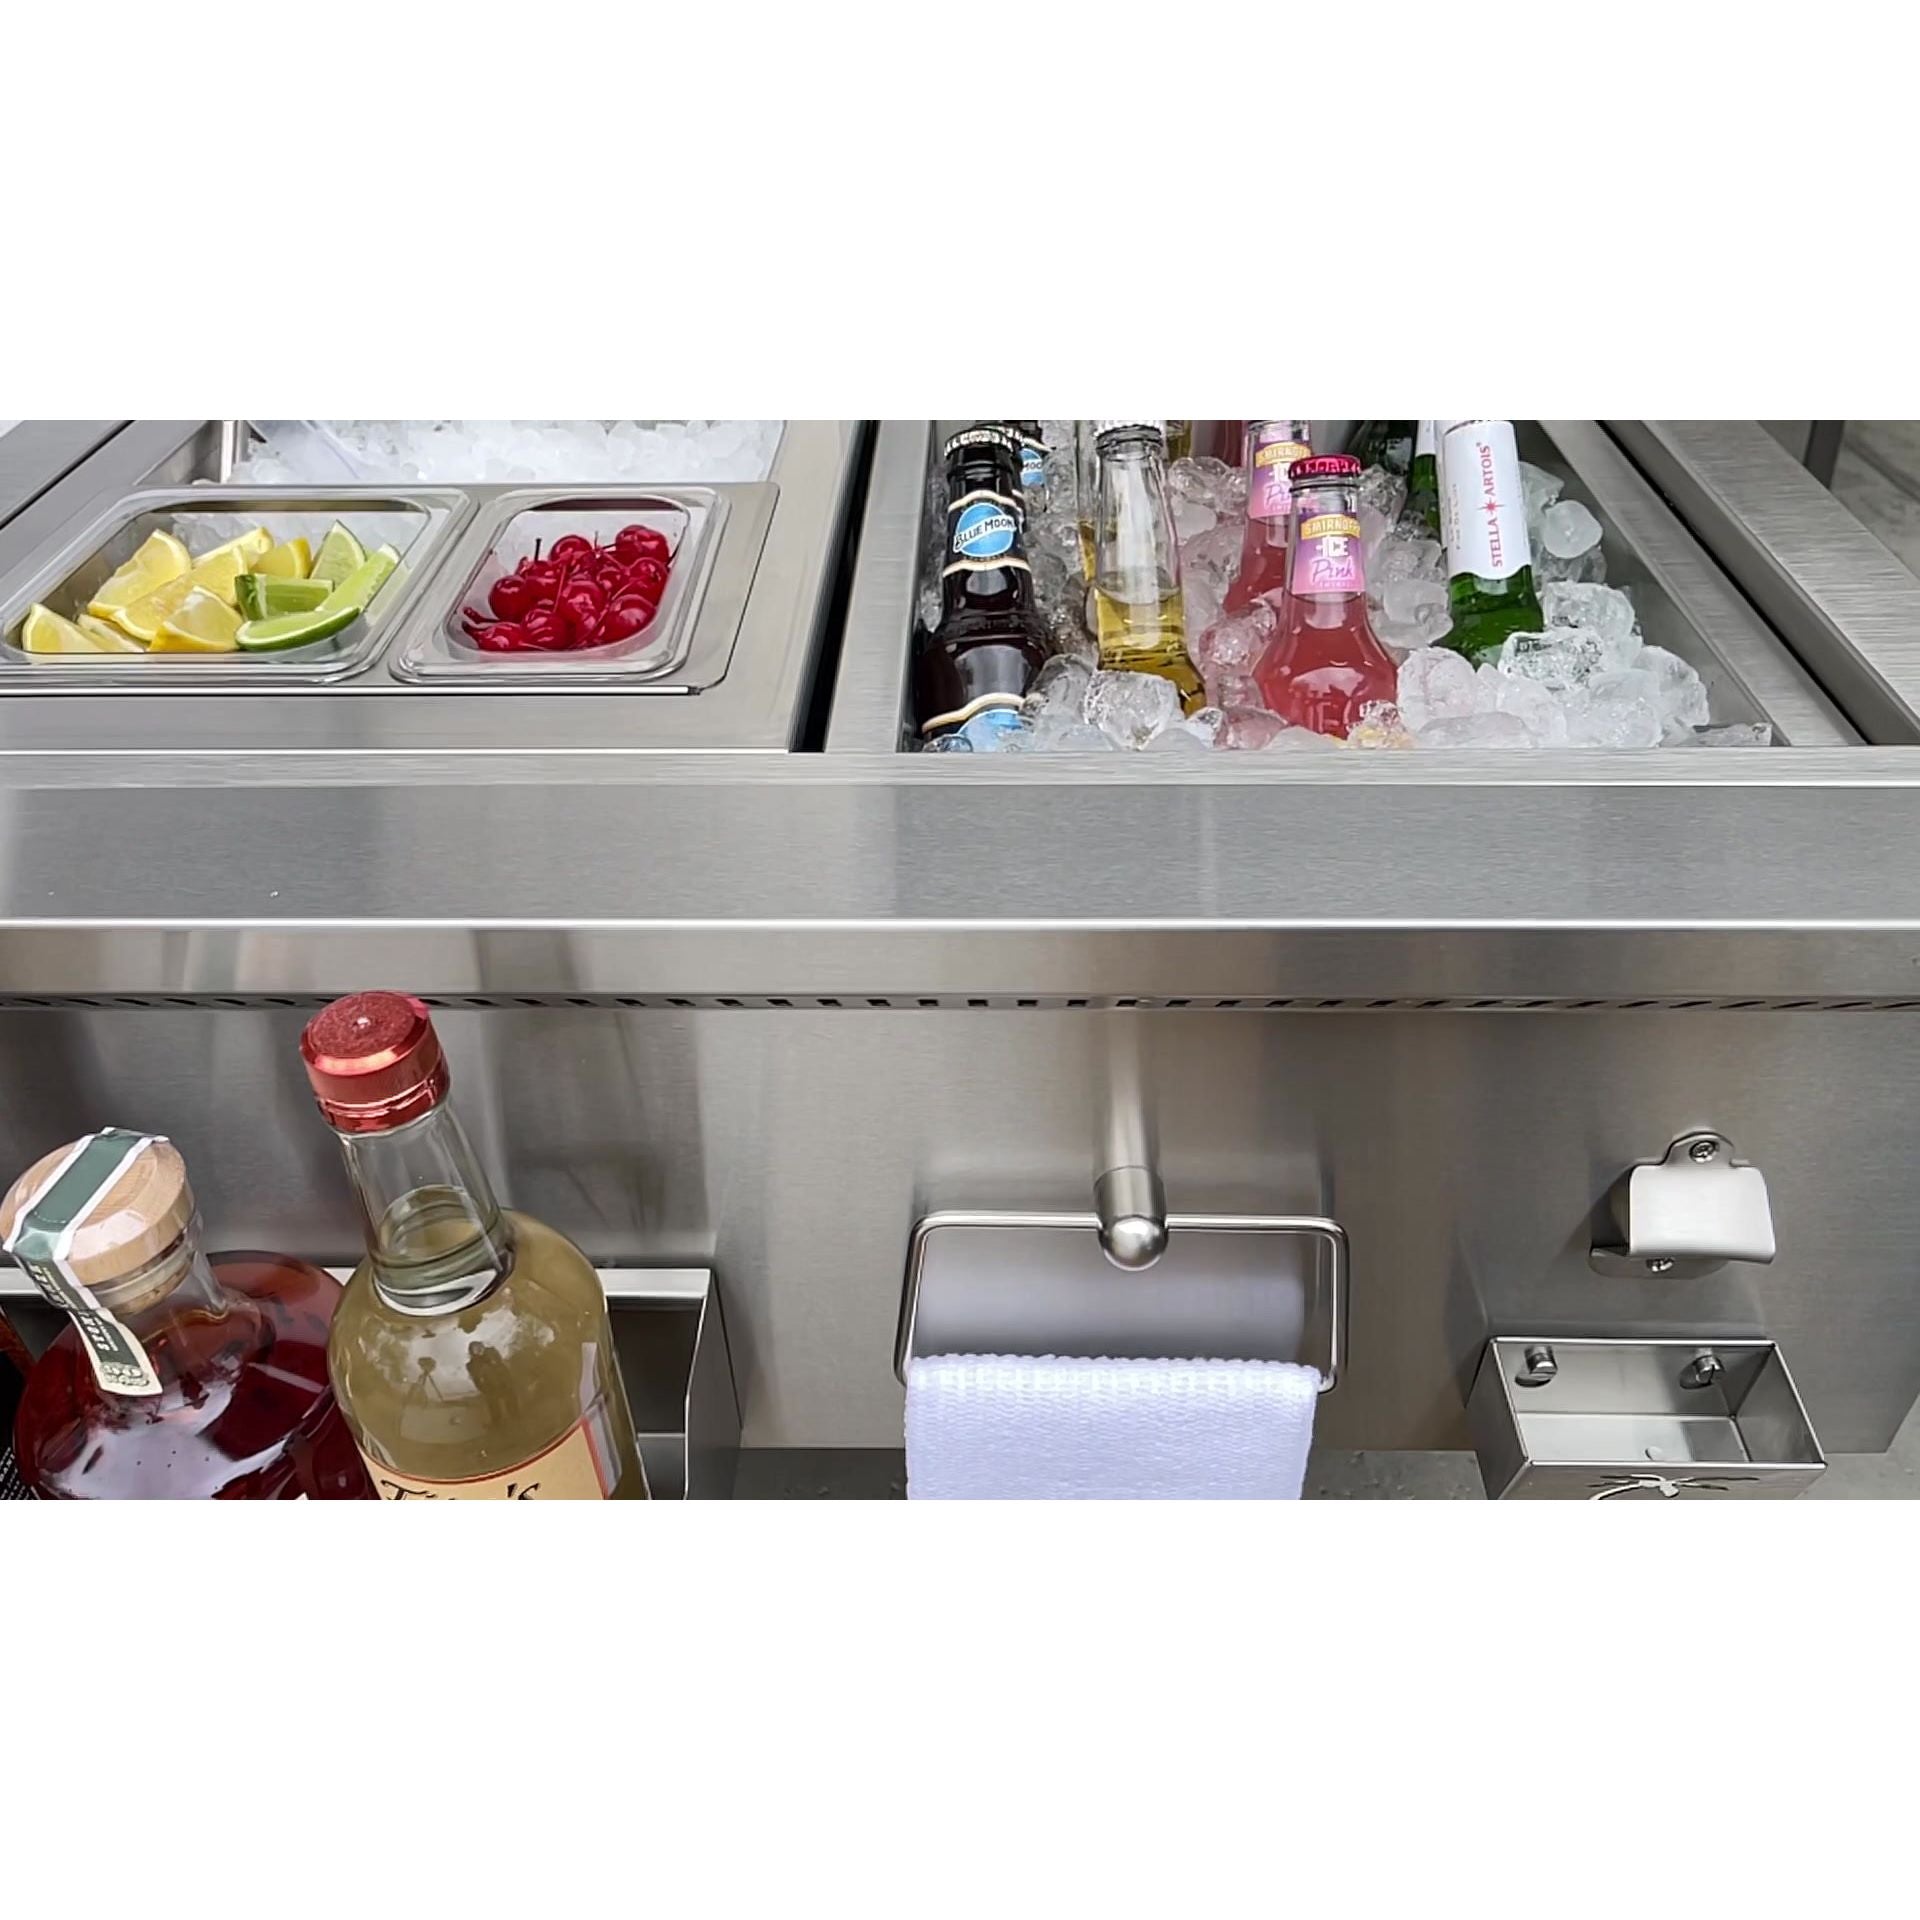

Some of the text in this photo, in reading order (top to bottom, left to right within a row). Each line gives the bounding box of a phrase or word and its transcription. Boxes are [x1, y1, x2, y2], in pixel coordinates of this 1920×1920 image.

[954, 518, 1014, 547] BLUE MOON
[1488, 517, 1503, 567] STELLA
[1316, 536, 1348, 557] ICE
[1312, 557, 1353, 582] Pink
